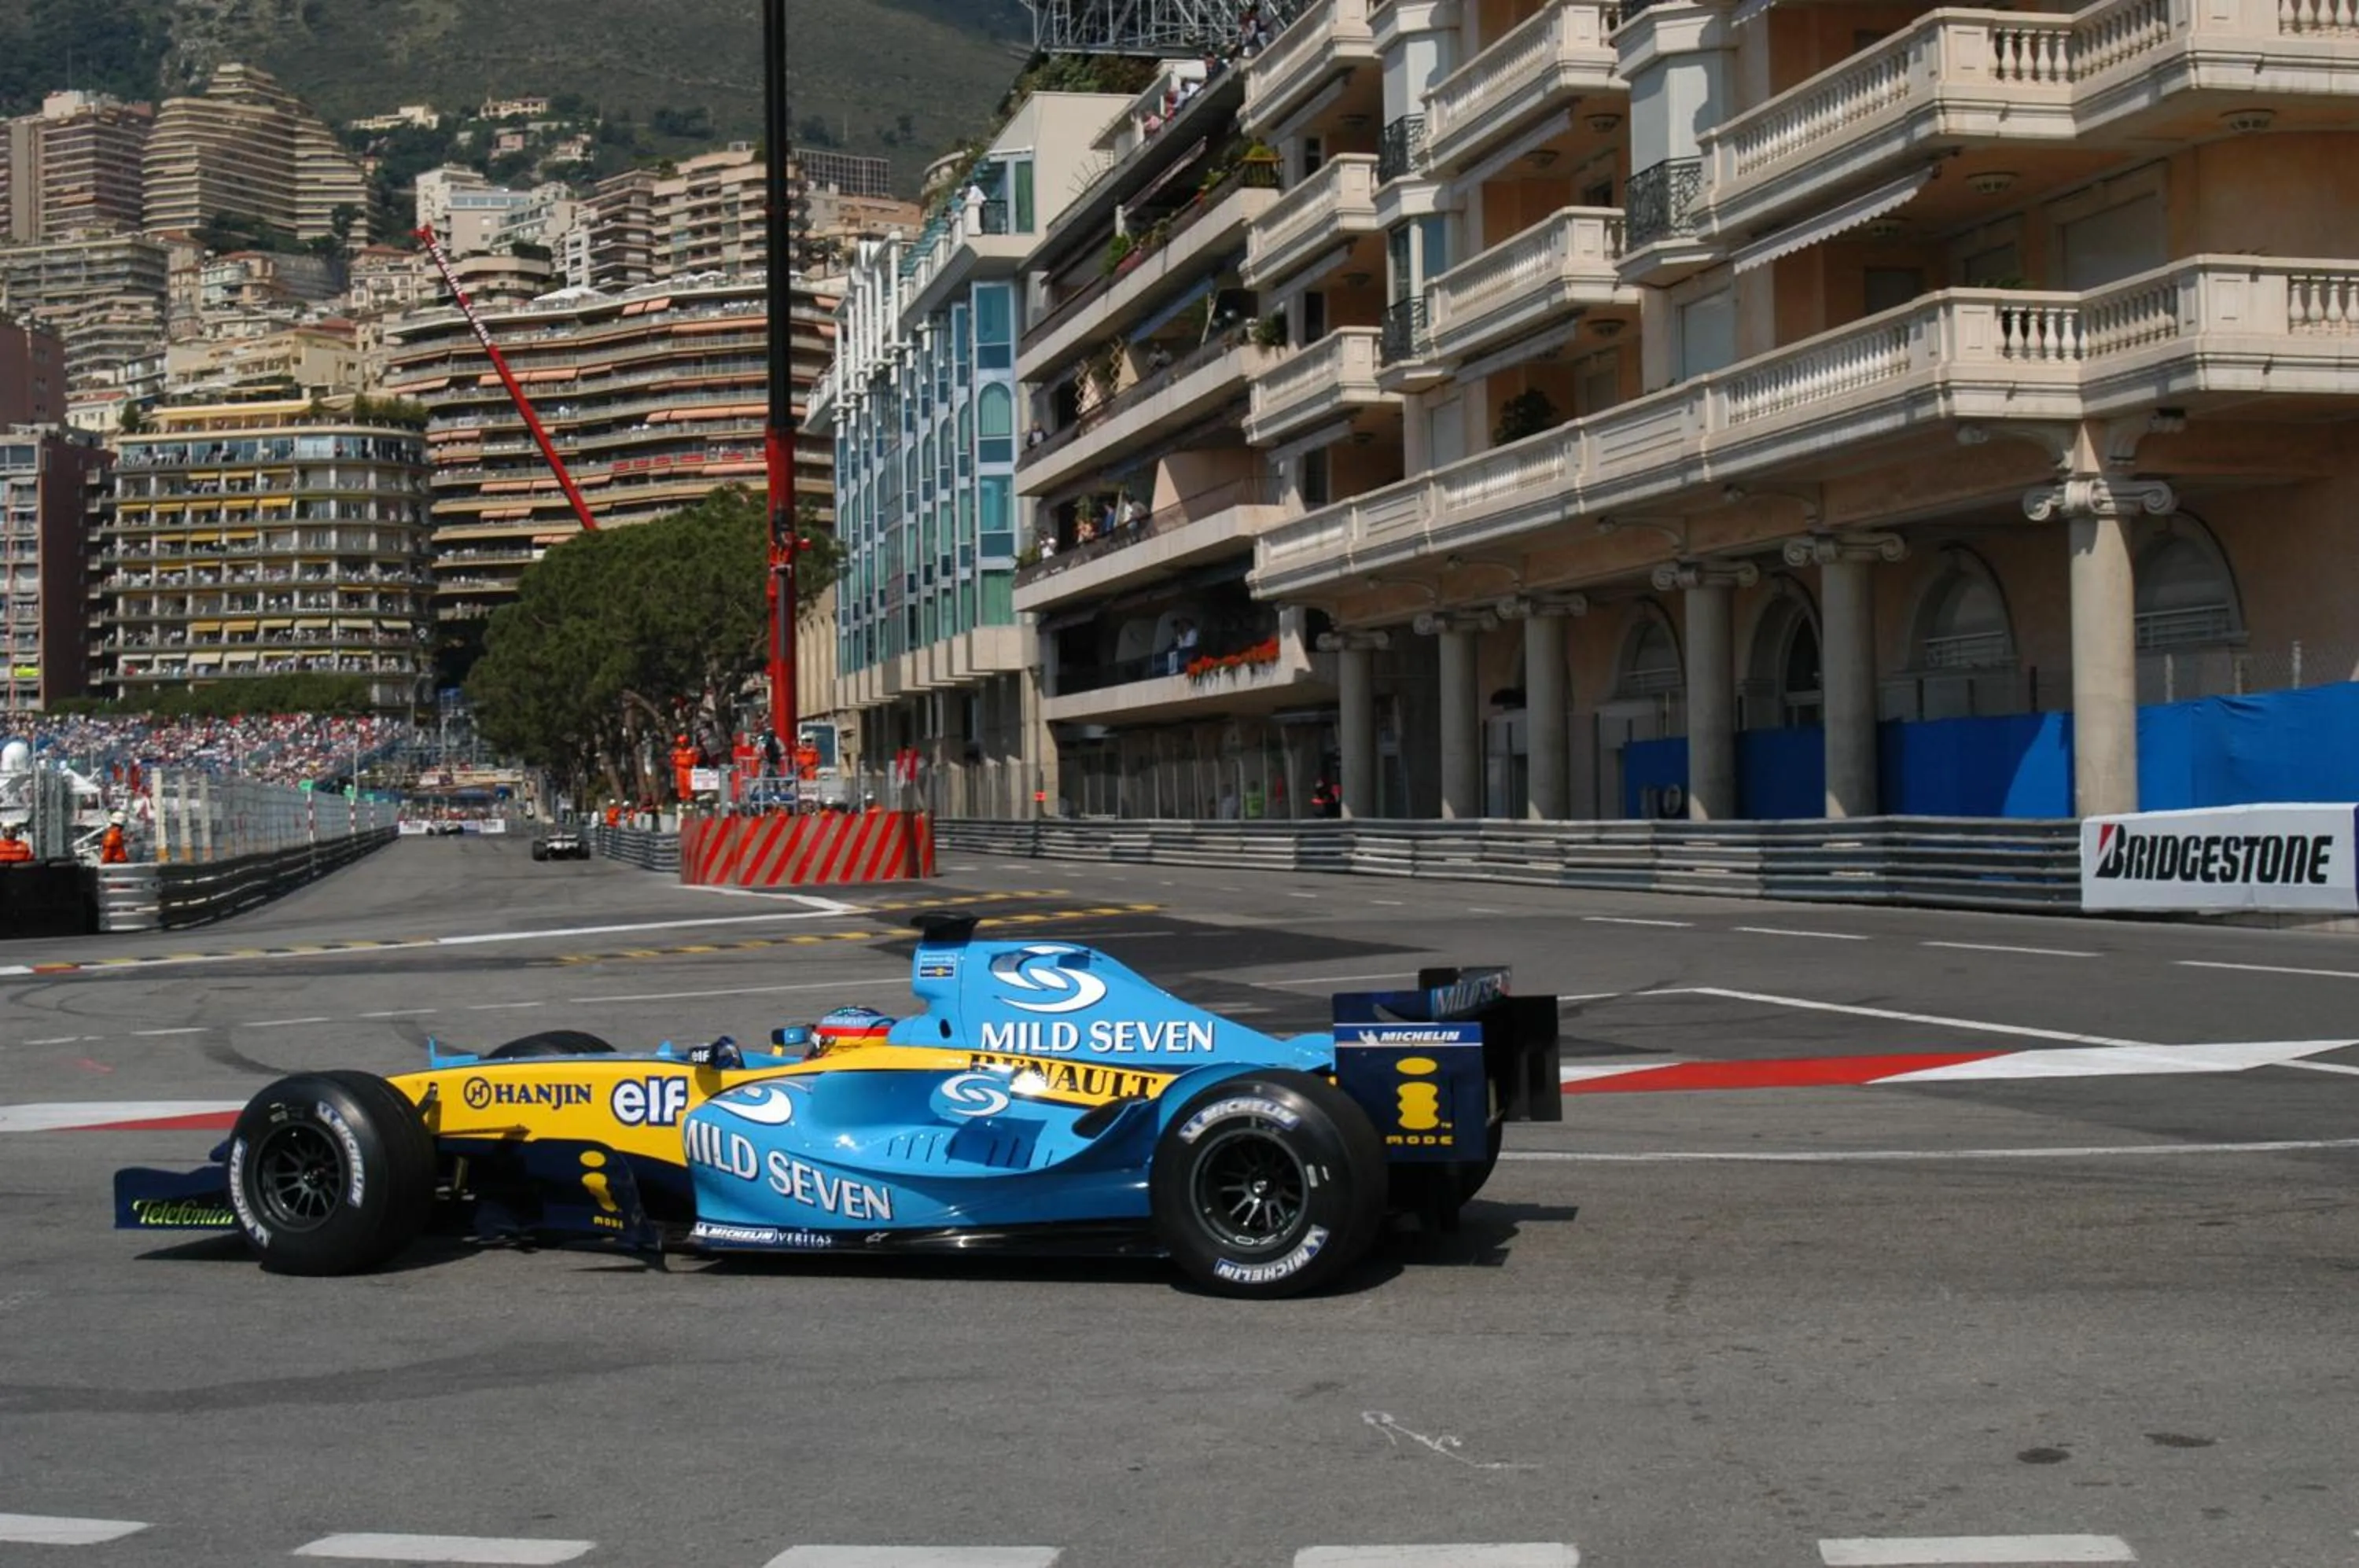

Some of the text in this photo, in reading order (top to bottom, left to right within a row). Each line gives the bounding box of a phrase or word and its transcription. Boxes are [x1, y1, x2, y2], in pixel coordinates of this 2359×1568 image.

[2095, 823, 2333, 884] BRIDGESTONE
[981, 1020, 1215, 1053] MILD SEVEN
[1381, 1031, 1461, 1042] MICHELIN
[969, 1052, 1158, 1100] RNAULT
[494, 1084, 591, 1110] HANJIN
[610, 1077, 689, 1126] elf
[1200, 1099, 1297, 1127] MICHELIN
[333, 1116, 364, 1207] MICHELIN
[687, 1118, 894, 1220] MILD SEVEN
[230, 1138, 255, 1230] MICHELIN
[708, 1226, 775, 1241] MICHELIN
[1217, 1247, 1311, 1282] MICHELIN
